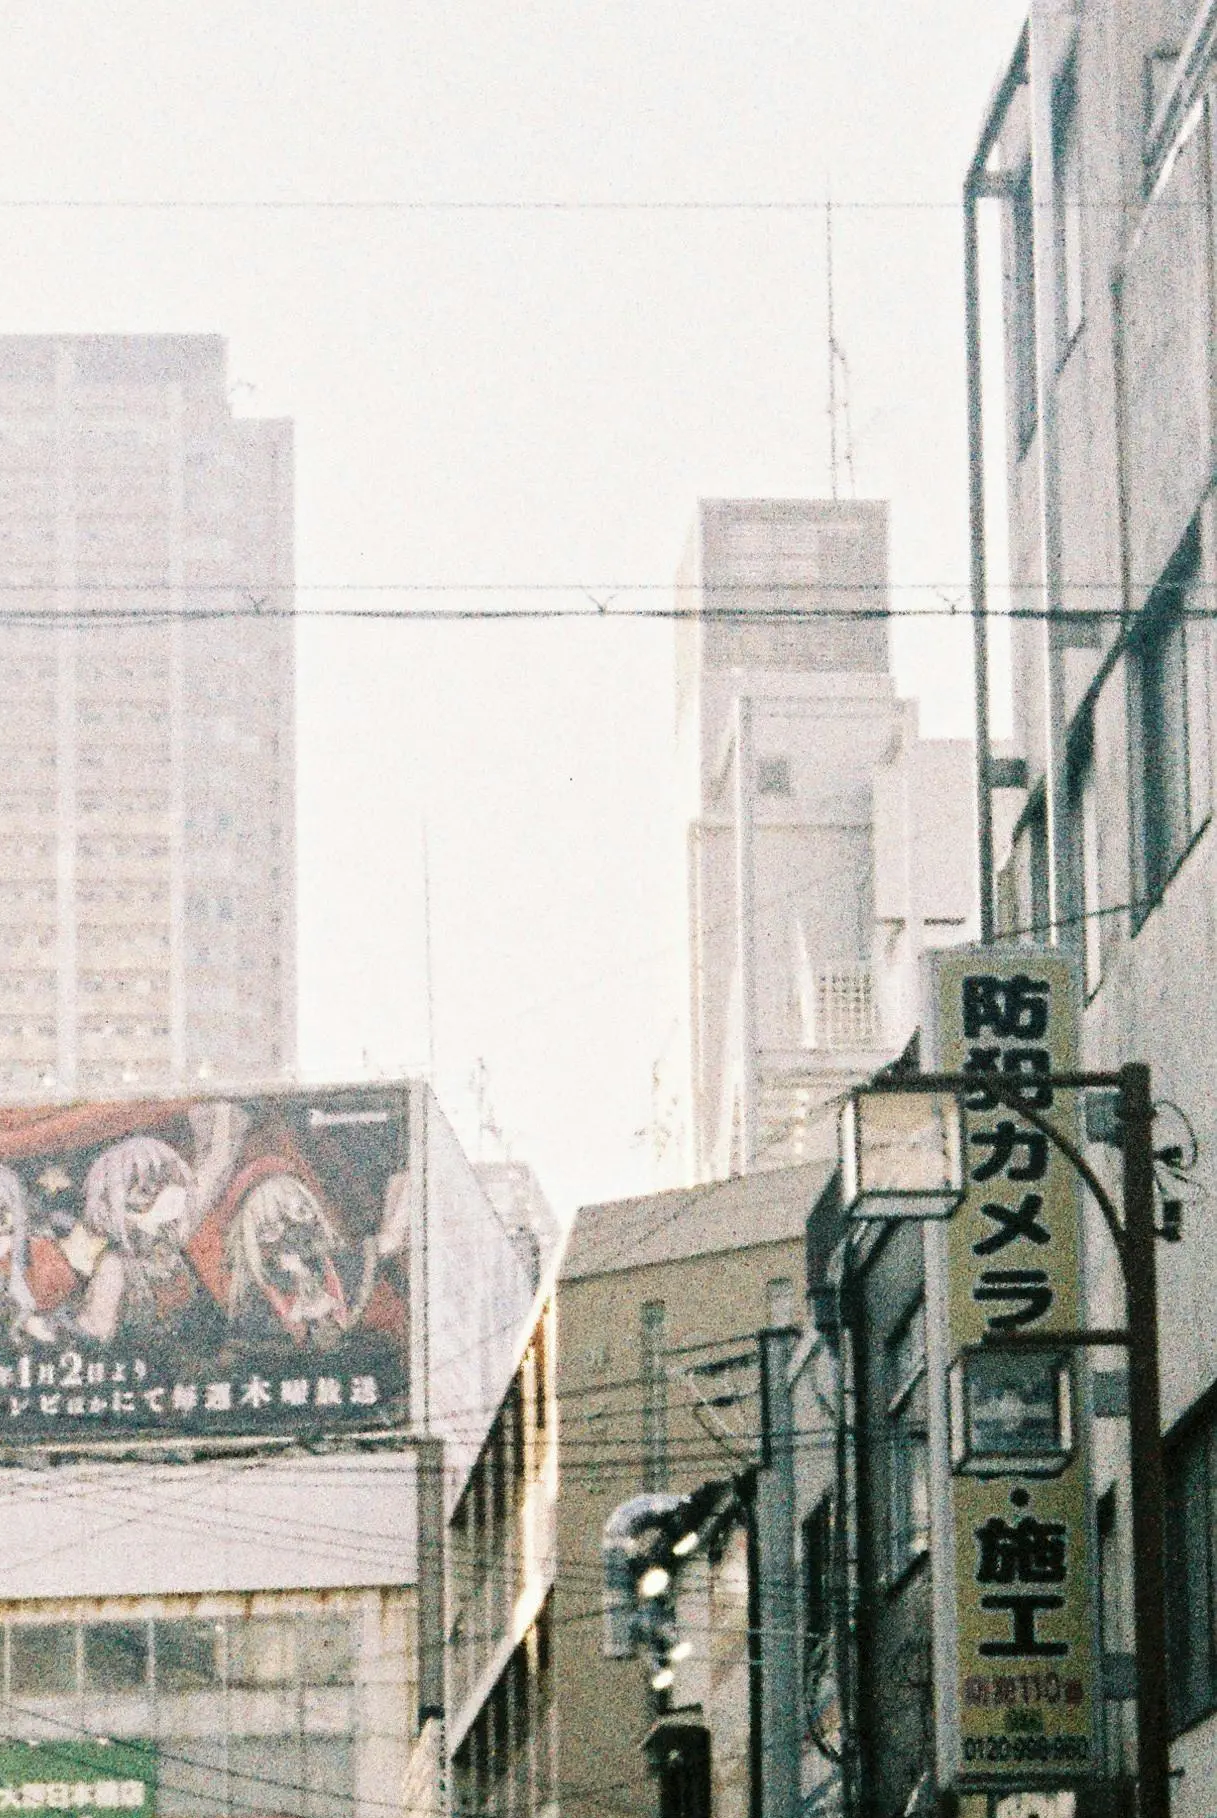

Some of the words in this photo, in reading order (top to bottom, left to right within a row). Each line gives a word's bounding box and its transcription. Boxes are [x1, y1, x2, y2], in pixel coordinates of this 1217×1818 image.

[961, 974, 1053, 1329] 防犯カメラ
